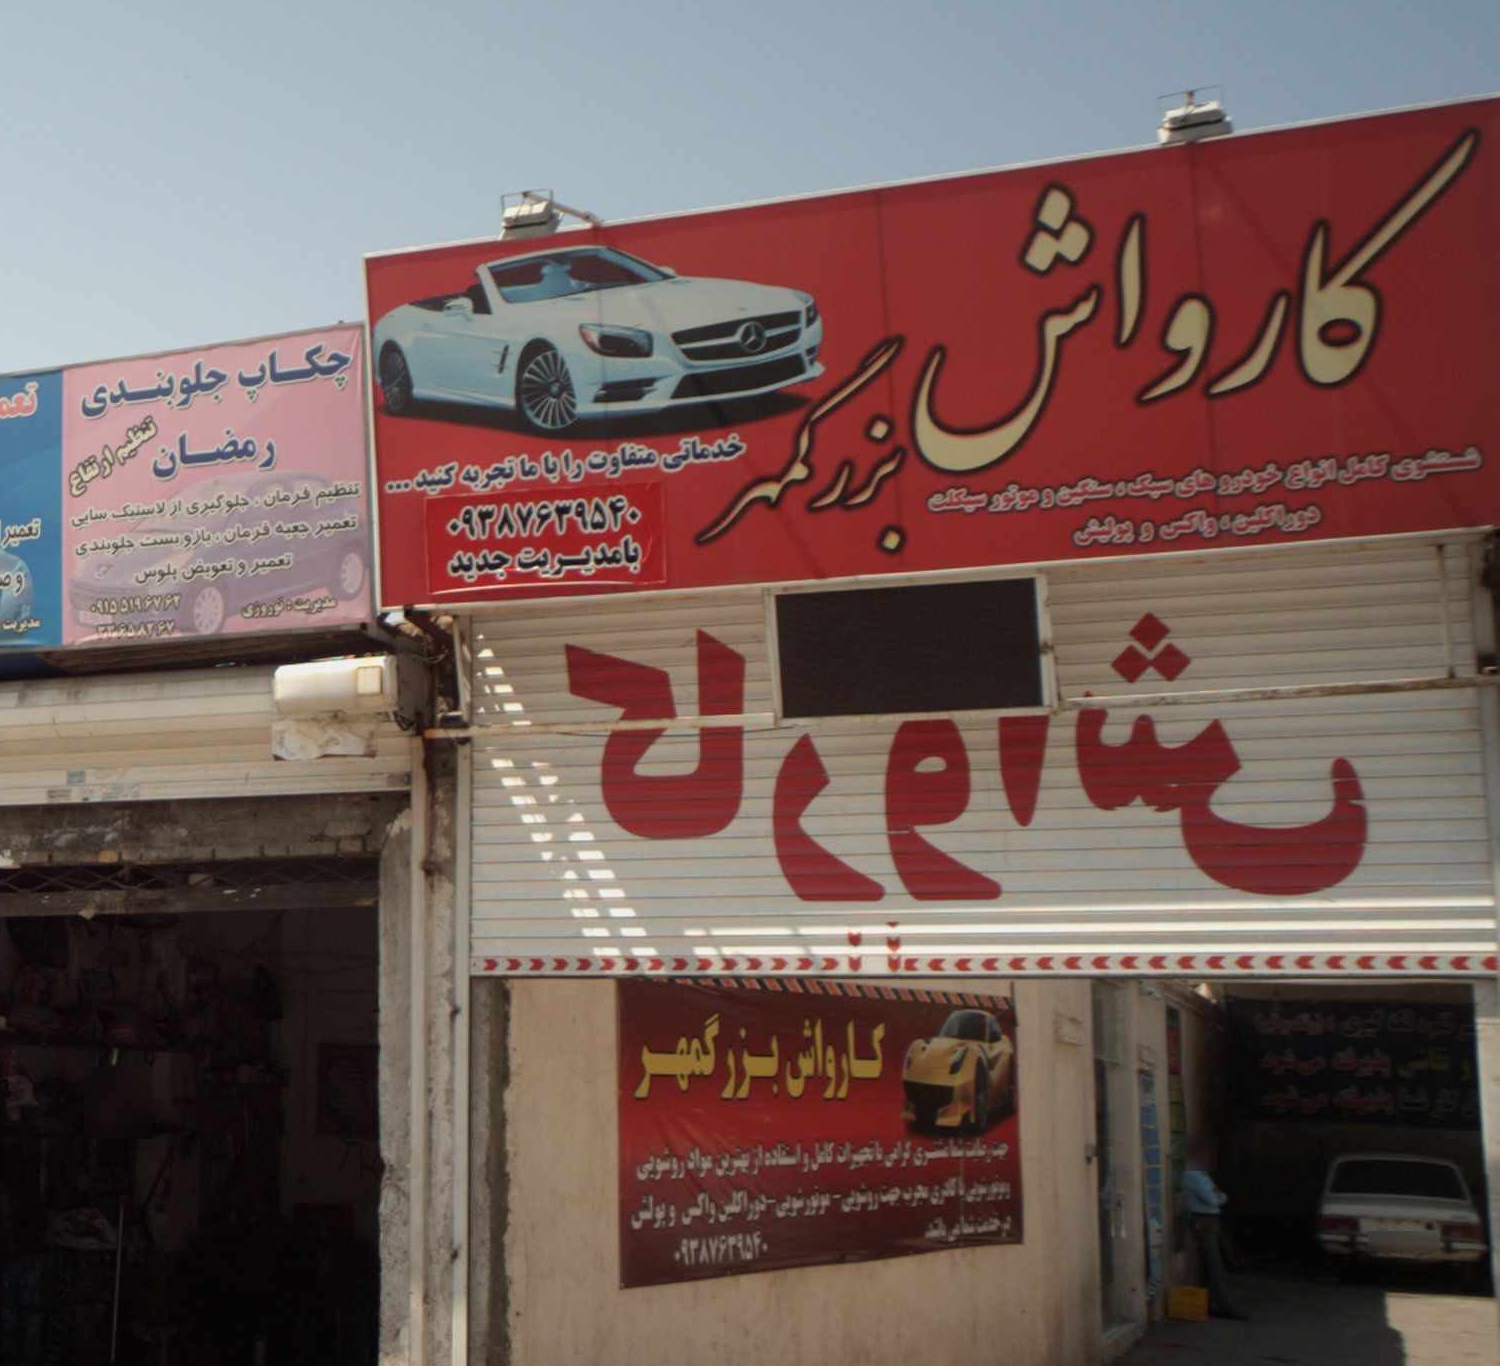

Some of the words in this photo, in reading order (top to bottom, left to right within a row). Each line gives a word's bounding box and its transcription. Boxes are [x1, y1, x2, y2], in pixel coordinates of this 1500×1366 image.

[913, 128, 1479, 474] کارواش
[238, 344, 352, 401] چکاپ
[81, 358, 229, 419] جلوبندی
[116, 415, 158, 466] تنظیم
[661, 433, 747, 471] خدماتی
[152, 428, 277, 479] رمضان
[564, 450, 585, 481] را
[587, 443, 658, 478] متفاوت
[68, 445, 115, 497] ارتفاع
[414, 463, 456, 495] کنید
[461, 463, 515, 493] تجربه
[519, 456, 539, 480] ما
[1283, 458, 1338, 490] انواع
[1338, 453, 1391, 485] کامل
[263, 486, 311, 509] فرمان
[315, 482, 360, 506] تنظیم
[1041, 488, 1054, 508] و
[1056, 478, 1114, 506] سنگین
[112, 500, 166, 520] لاستیک
[170, 499, 183, 521] از
[186, 493, 250, 516] جلوگیری
[275, 521, 310, 537] جعبه
[315, 516, 359, 536] تعمیر
[447, 495, 641, 539] ۰۹۳۸۷۶۳۹۵۴۰
[2, 518, 41, 548] تعمیر
[224, 522, 271, 543] فرمان
[1140, 522, 1154, 543] و
[74, 539, 136, 556] جلوبندی
[134, 566, 178, 585] پلوس
[182, 559, 234, 581] تعویض
[238, 561, 247, 576] و
[251, 554, 292, 575] تعمیر
[449, 548, 512, 581] جدید
[14, 572, 25, 594] و
[242, 599, 286, 619] نوروزی
[294, 596, 338, 615] مدیریت
[2, 619, 42, 633] مدیریت
[633, 1013, 780, 1100] بزرگمهر
[785, 1018, 886, 1100] کارواش
